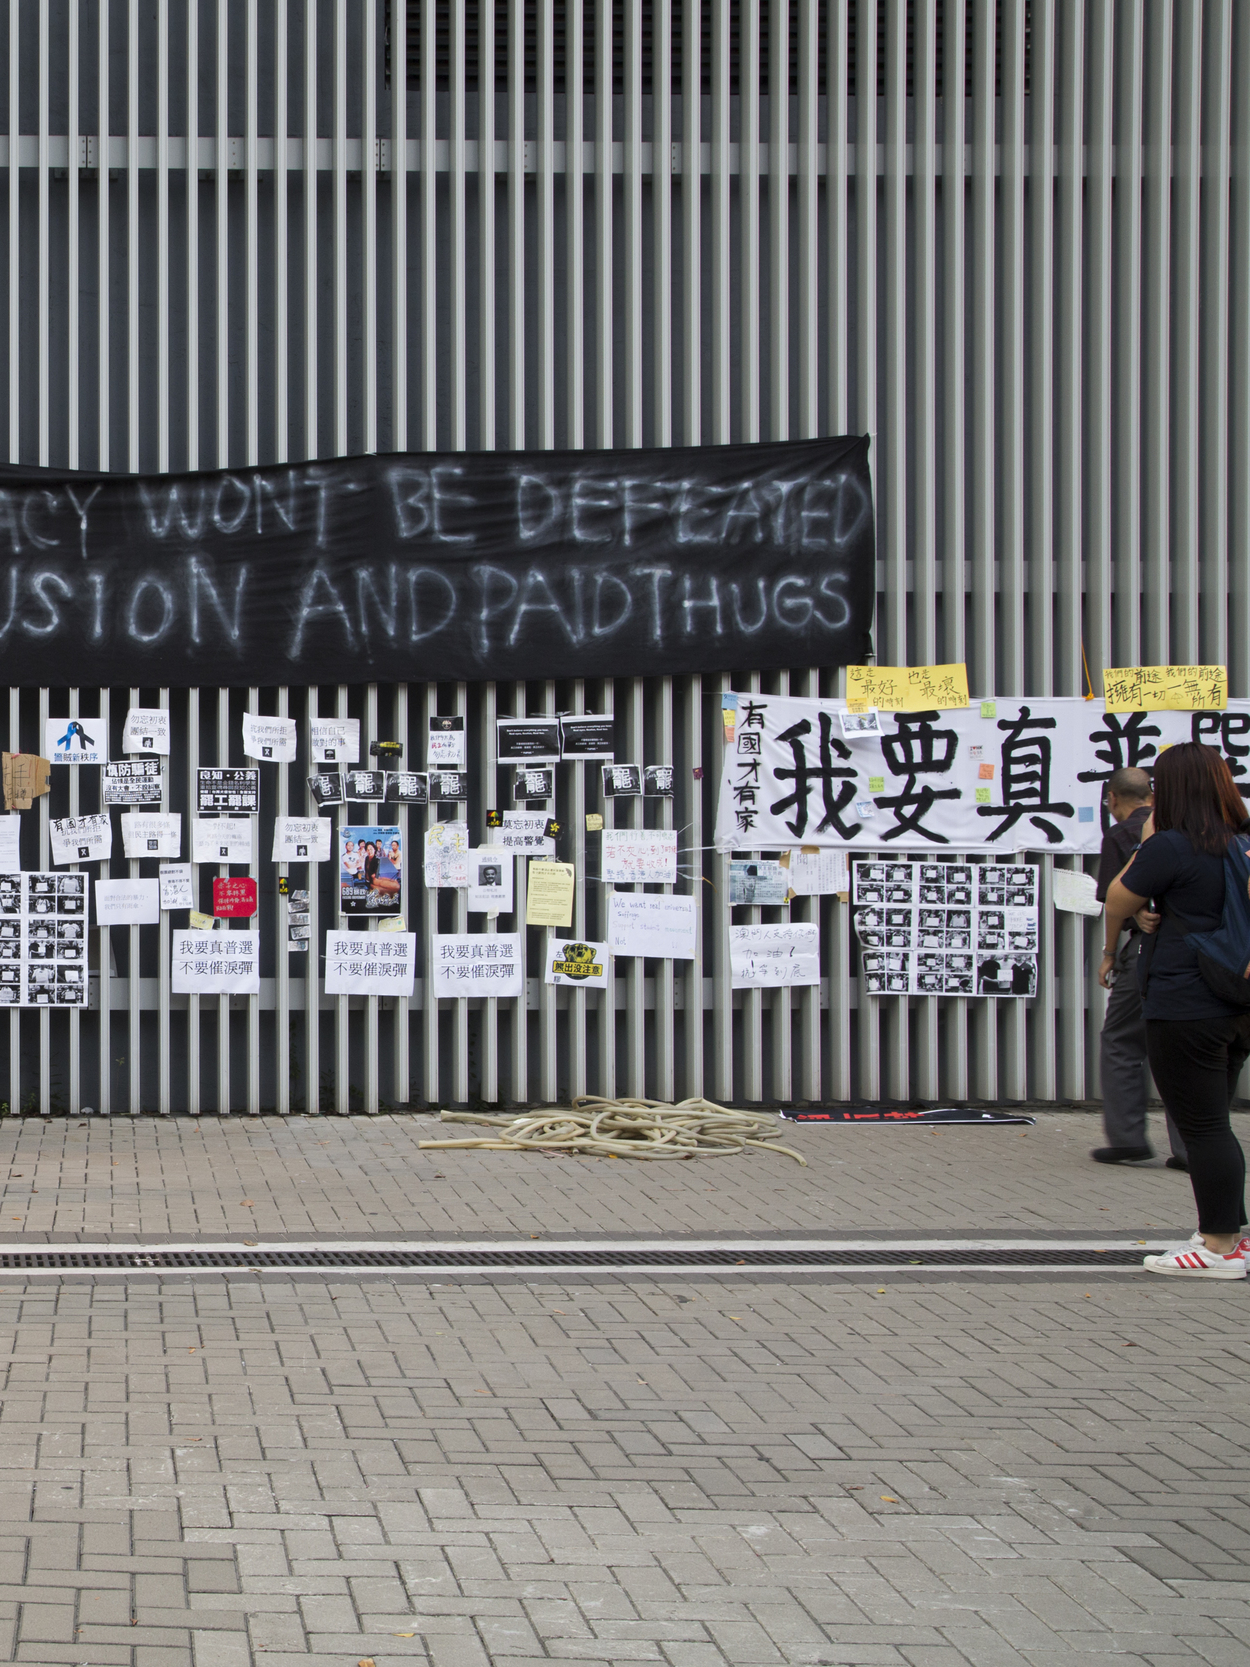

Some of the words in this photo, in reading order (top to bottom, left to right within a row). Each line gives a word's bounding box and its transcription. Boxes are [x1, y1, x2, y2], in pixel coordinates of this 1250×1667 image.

[386, 467, 478, 542] BE
[510, 468, 868, 548] DEFEATED
[286, 567, 456, 663] AND
[471, 564, 632, 663] PAID
[626, 564, 850, 645] THUGS
[1106, 668, 1163, 684] 我們的前途
[1166, 667, 1227, 684] 我們的前途
[733, 700, 768, 833] 有國才有家
[504, 819, 545, 830] 莫忘初衷
[613, 898, 626, 908] We
[629, 901, 646, 909] want
[179, 940, 253, 955] 我要真普選
[333, 941, 408, 957] 我要真普選
[440, 944, 514, 959] 我要真普選
[179, 961, 254, 975] 不要催淚彈
[333, 962, 409, 977] 不要催淚彈
[440, 964, 515, 979] 不要催淚彈
